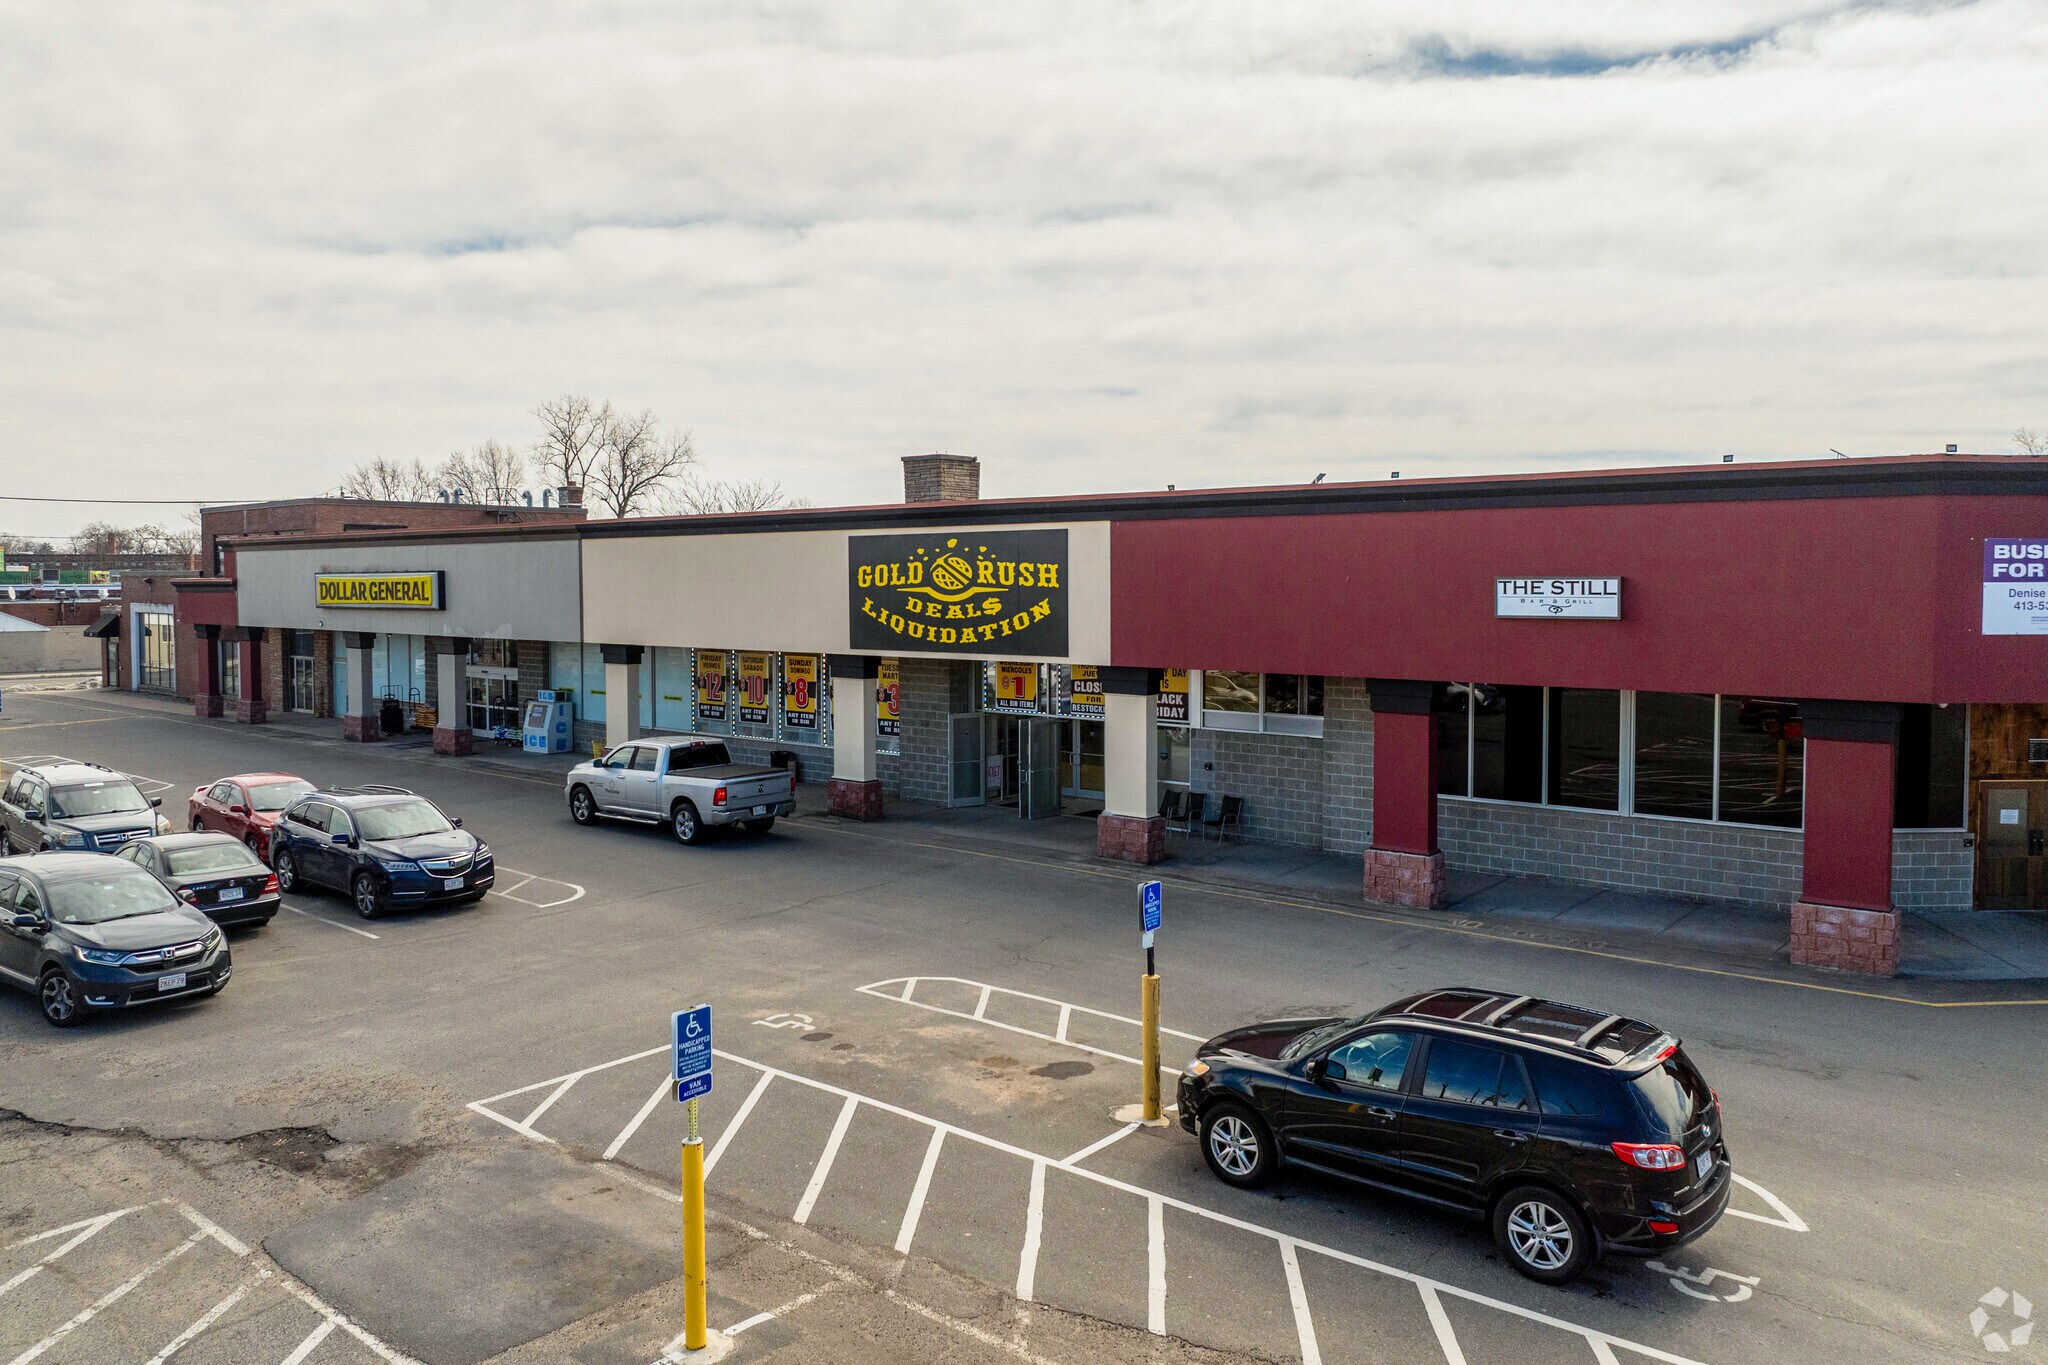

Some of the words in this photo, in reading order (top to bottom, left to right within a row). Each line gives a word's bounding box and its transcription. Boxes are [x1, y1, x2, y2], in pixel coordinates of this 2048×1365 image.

[1994, 544, 2048, 559] BUSI
[857, 560, 924, 588] GOLD
[976, 560, 1060, 588] RUSH
[1992, 563, 2044, 578] FOR
[318, 581, 367, 601] DOLLAR
[369, 580, 430, 602] GENERAL
[1498, 580, 1545, 595] THE
[1551, 580, 1617, 596] STILL
[2008, 588, 2046, 598] Denise
[861, 596, 1052, 645] LIQUIDATION
[701, 654, 723, 662] FRIDAY
[742, 656, 764, 664] SATURDAY
[788, 659, 813, 667] SUNDAY
[790, 667, 811, 675] DOMINGO
[1001, 666, 1033, 674] MIERCOLES
[1172, 668, 1187, 678] DAY
[524, 735, 547, 748] ICE
[678, 1034, 711, 1050] HANDICAPPED
[684, 1043, 705, 1056] PARKING
[683, 1084, 707, 1098] ACCESSIBLE
[688, 1079, 702, 1090] VAN
